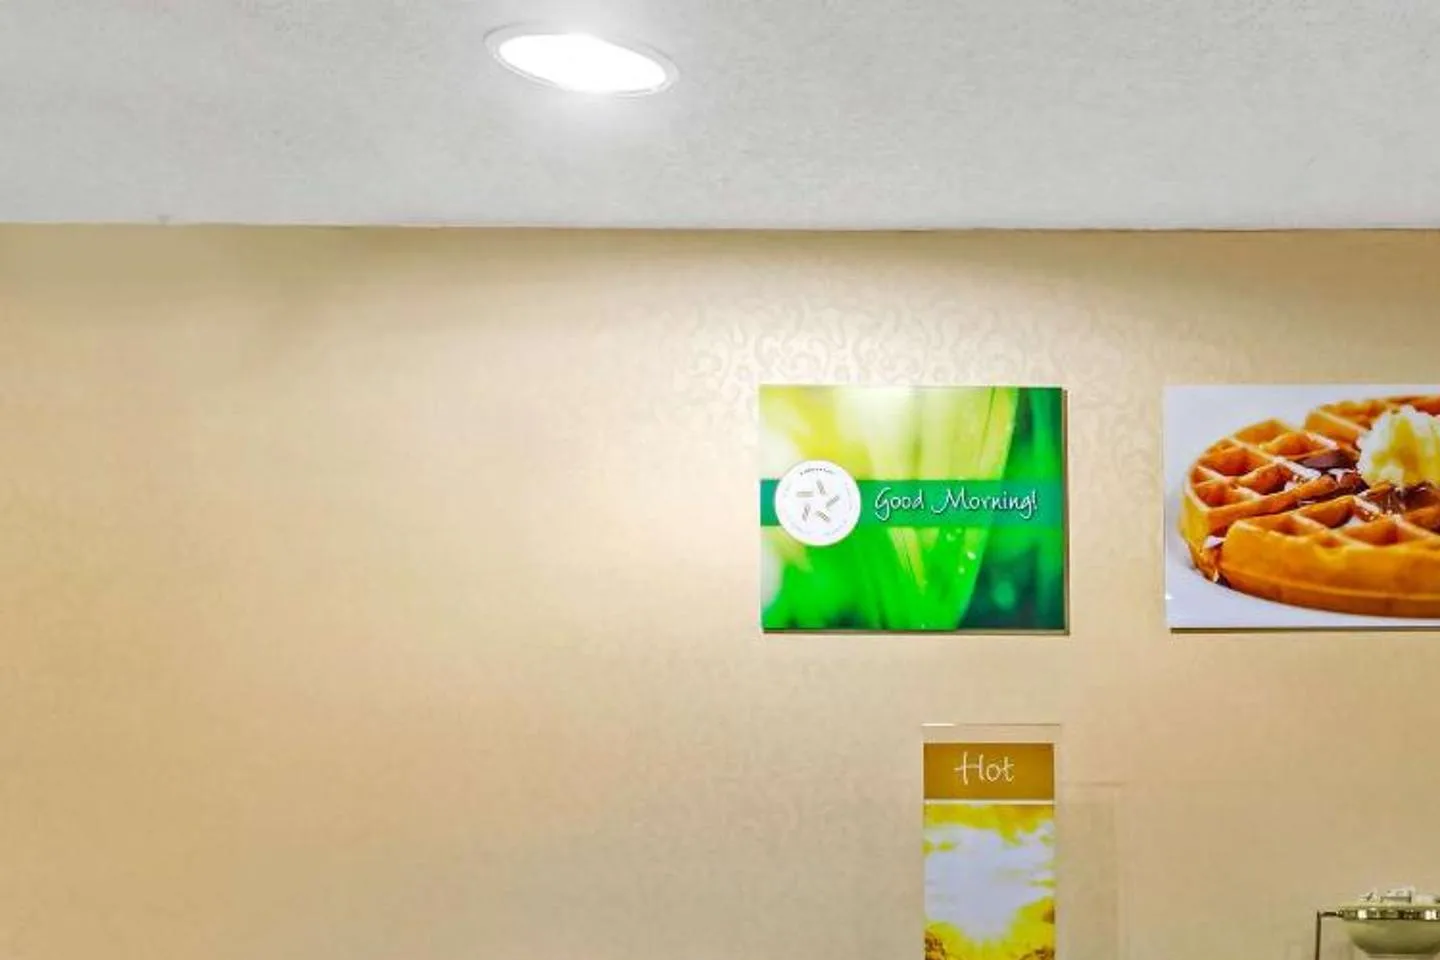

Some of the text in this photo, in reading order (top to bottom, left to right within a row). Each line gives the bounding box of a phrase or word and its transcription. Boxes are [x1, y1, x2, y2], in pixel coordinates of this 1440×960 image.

[874, 486, 1038, 521] Good Morning!
[953, 751, 1015, 785] Hot
